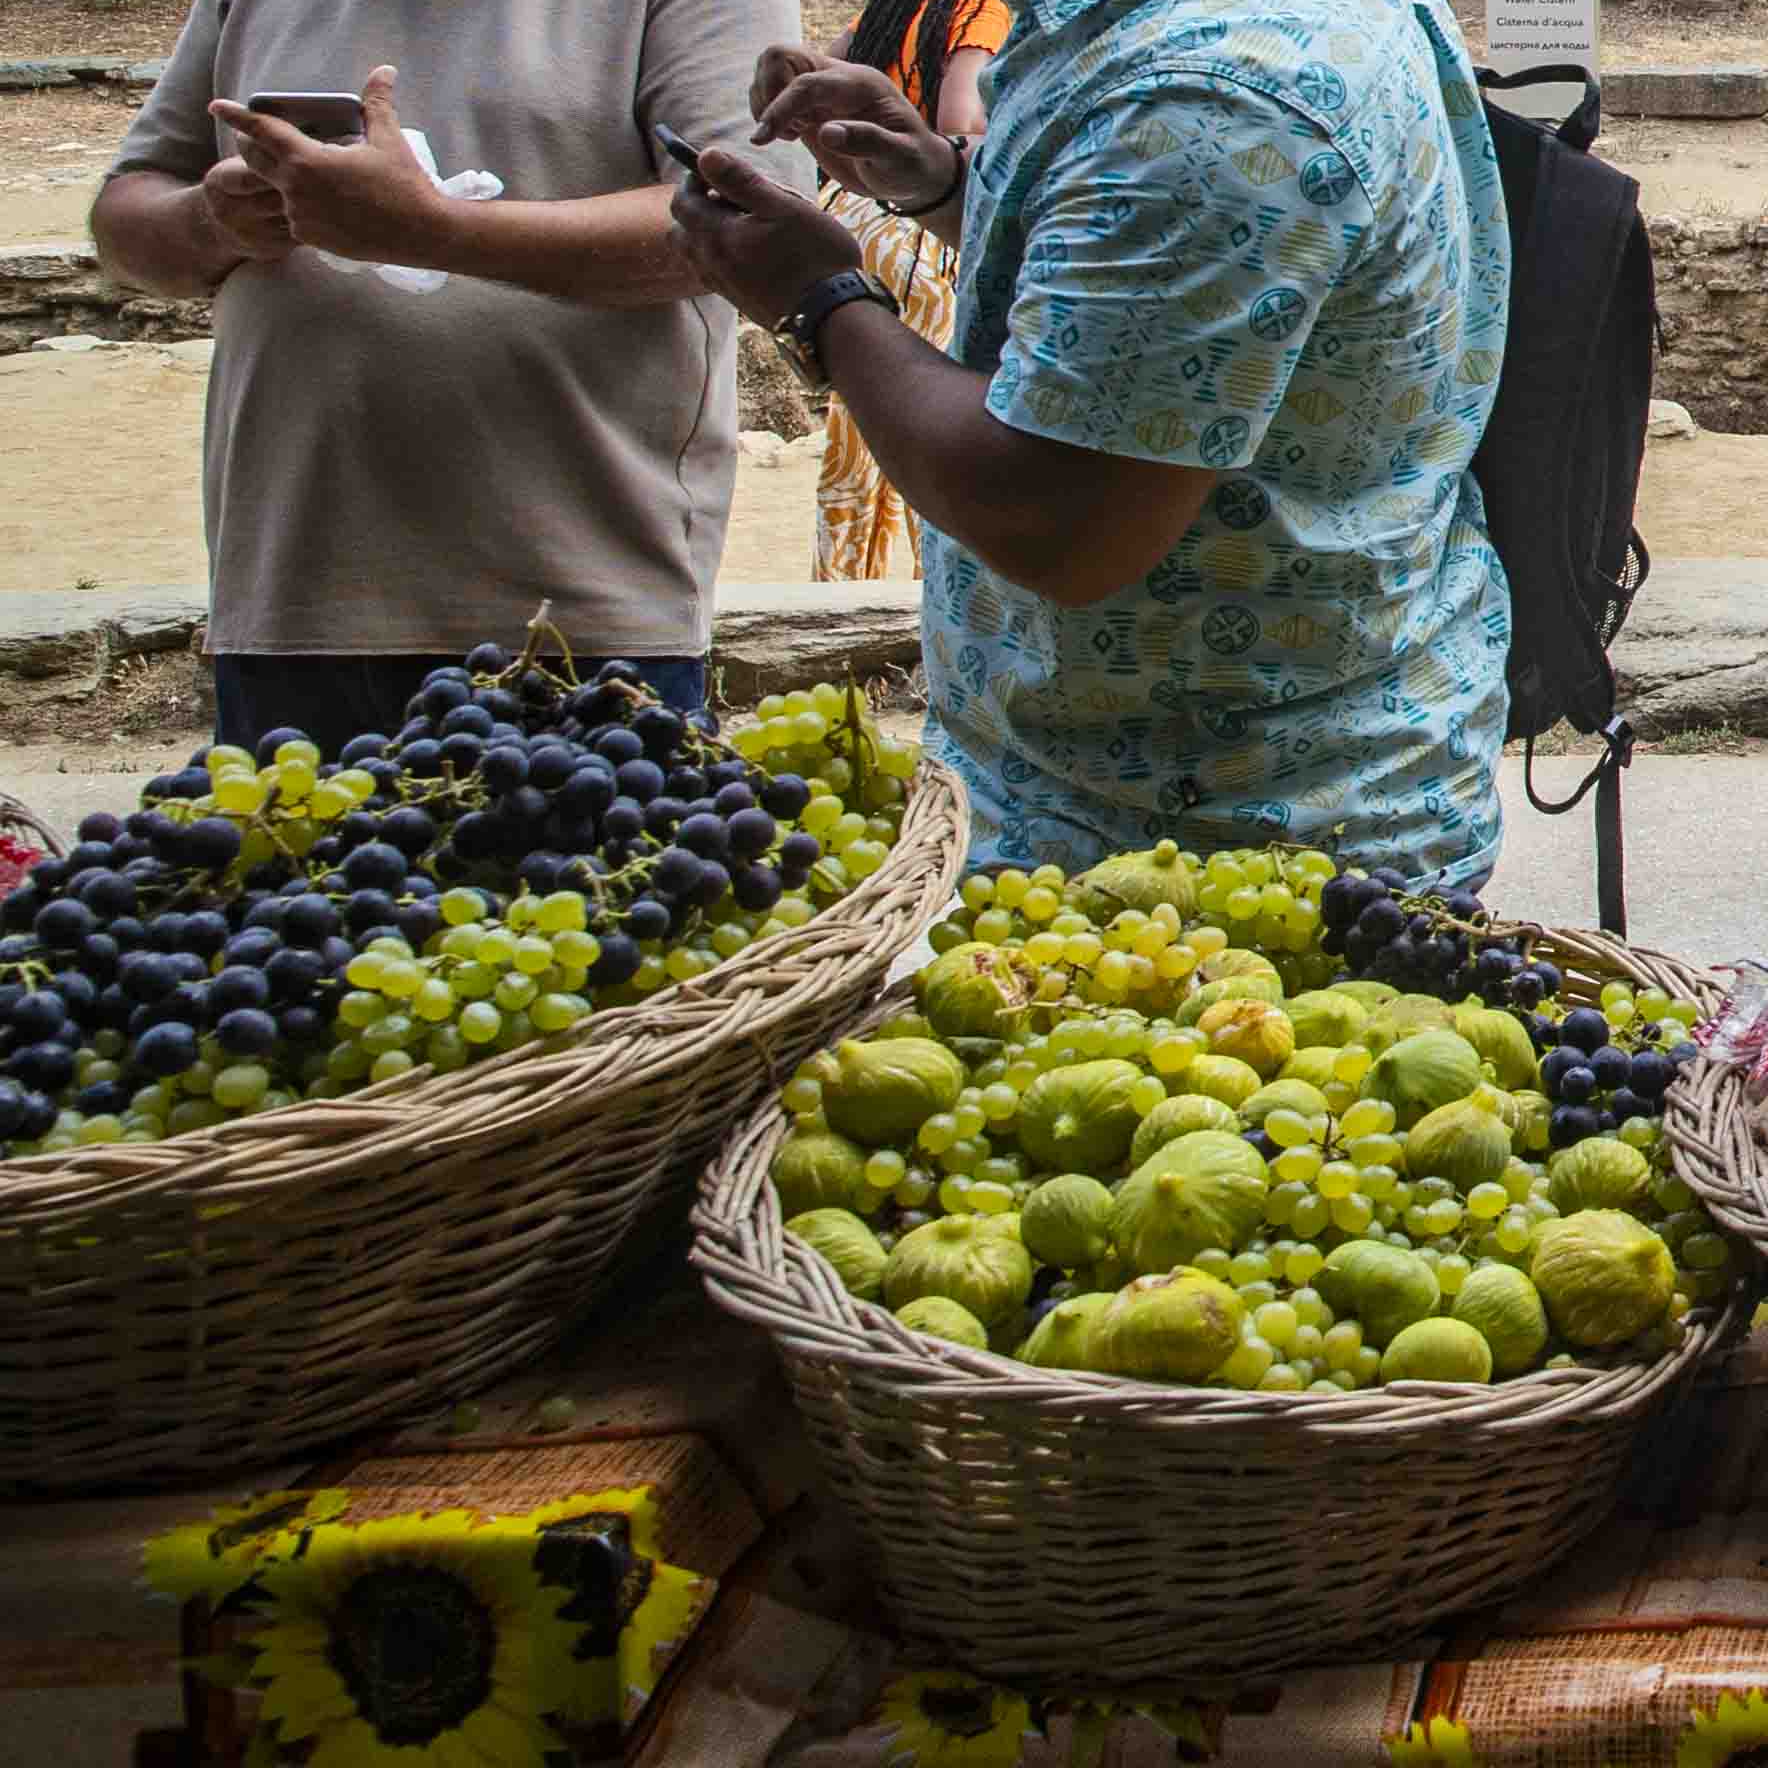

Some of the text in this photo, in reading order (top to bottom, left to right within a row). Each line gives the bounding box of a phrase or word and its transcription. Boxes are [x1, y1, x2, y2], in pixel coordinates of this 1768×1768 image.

[1496, 17, 1539, 27] Cisterna
[1542, 42, 1560, 51] для
[1562, 42, 1590, 51] воды
